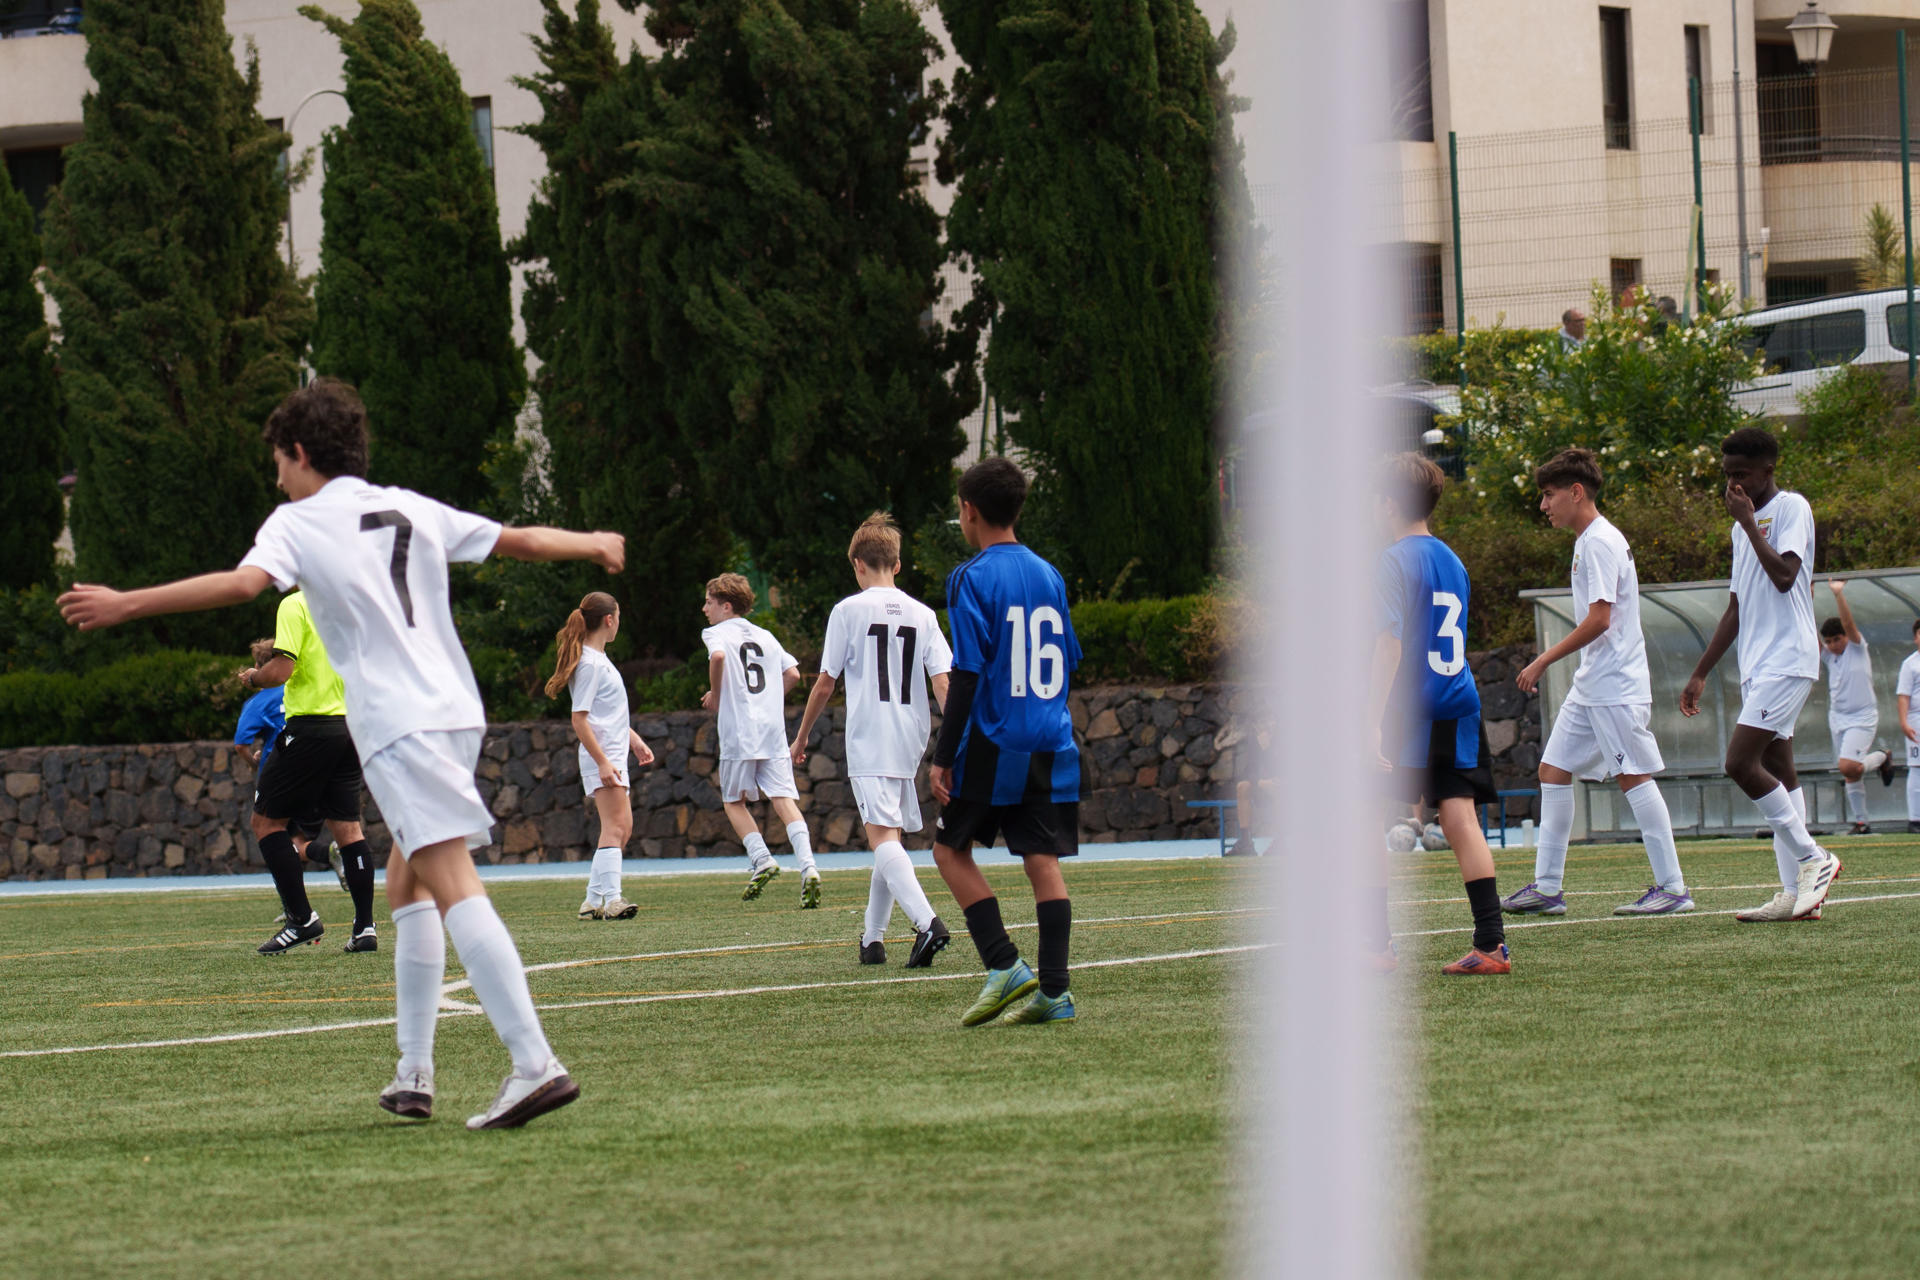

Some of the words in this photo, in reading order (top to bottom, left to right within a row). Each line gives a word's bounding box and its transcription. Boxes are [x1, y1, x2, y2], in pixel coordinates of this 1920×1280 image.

[360, 509, 416, 628] 7
[740, 642, 765, 694] 6
[867, 623, 917, 705] 11
[1006, 606, 1064, 699] 16
[1428, 592, 1464, 676] 3
